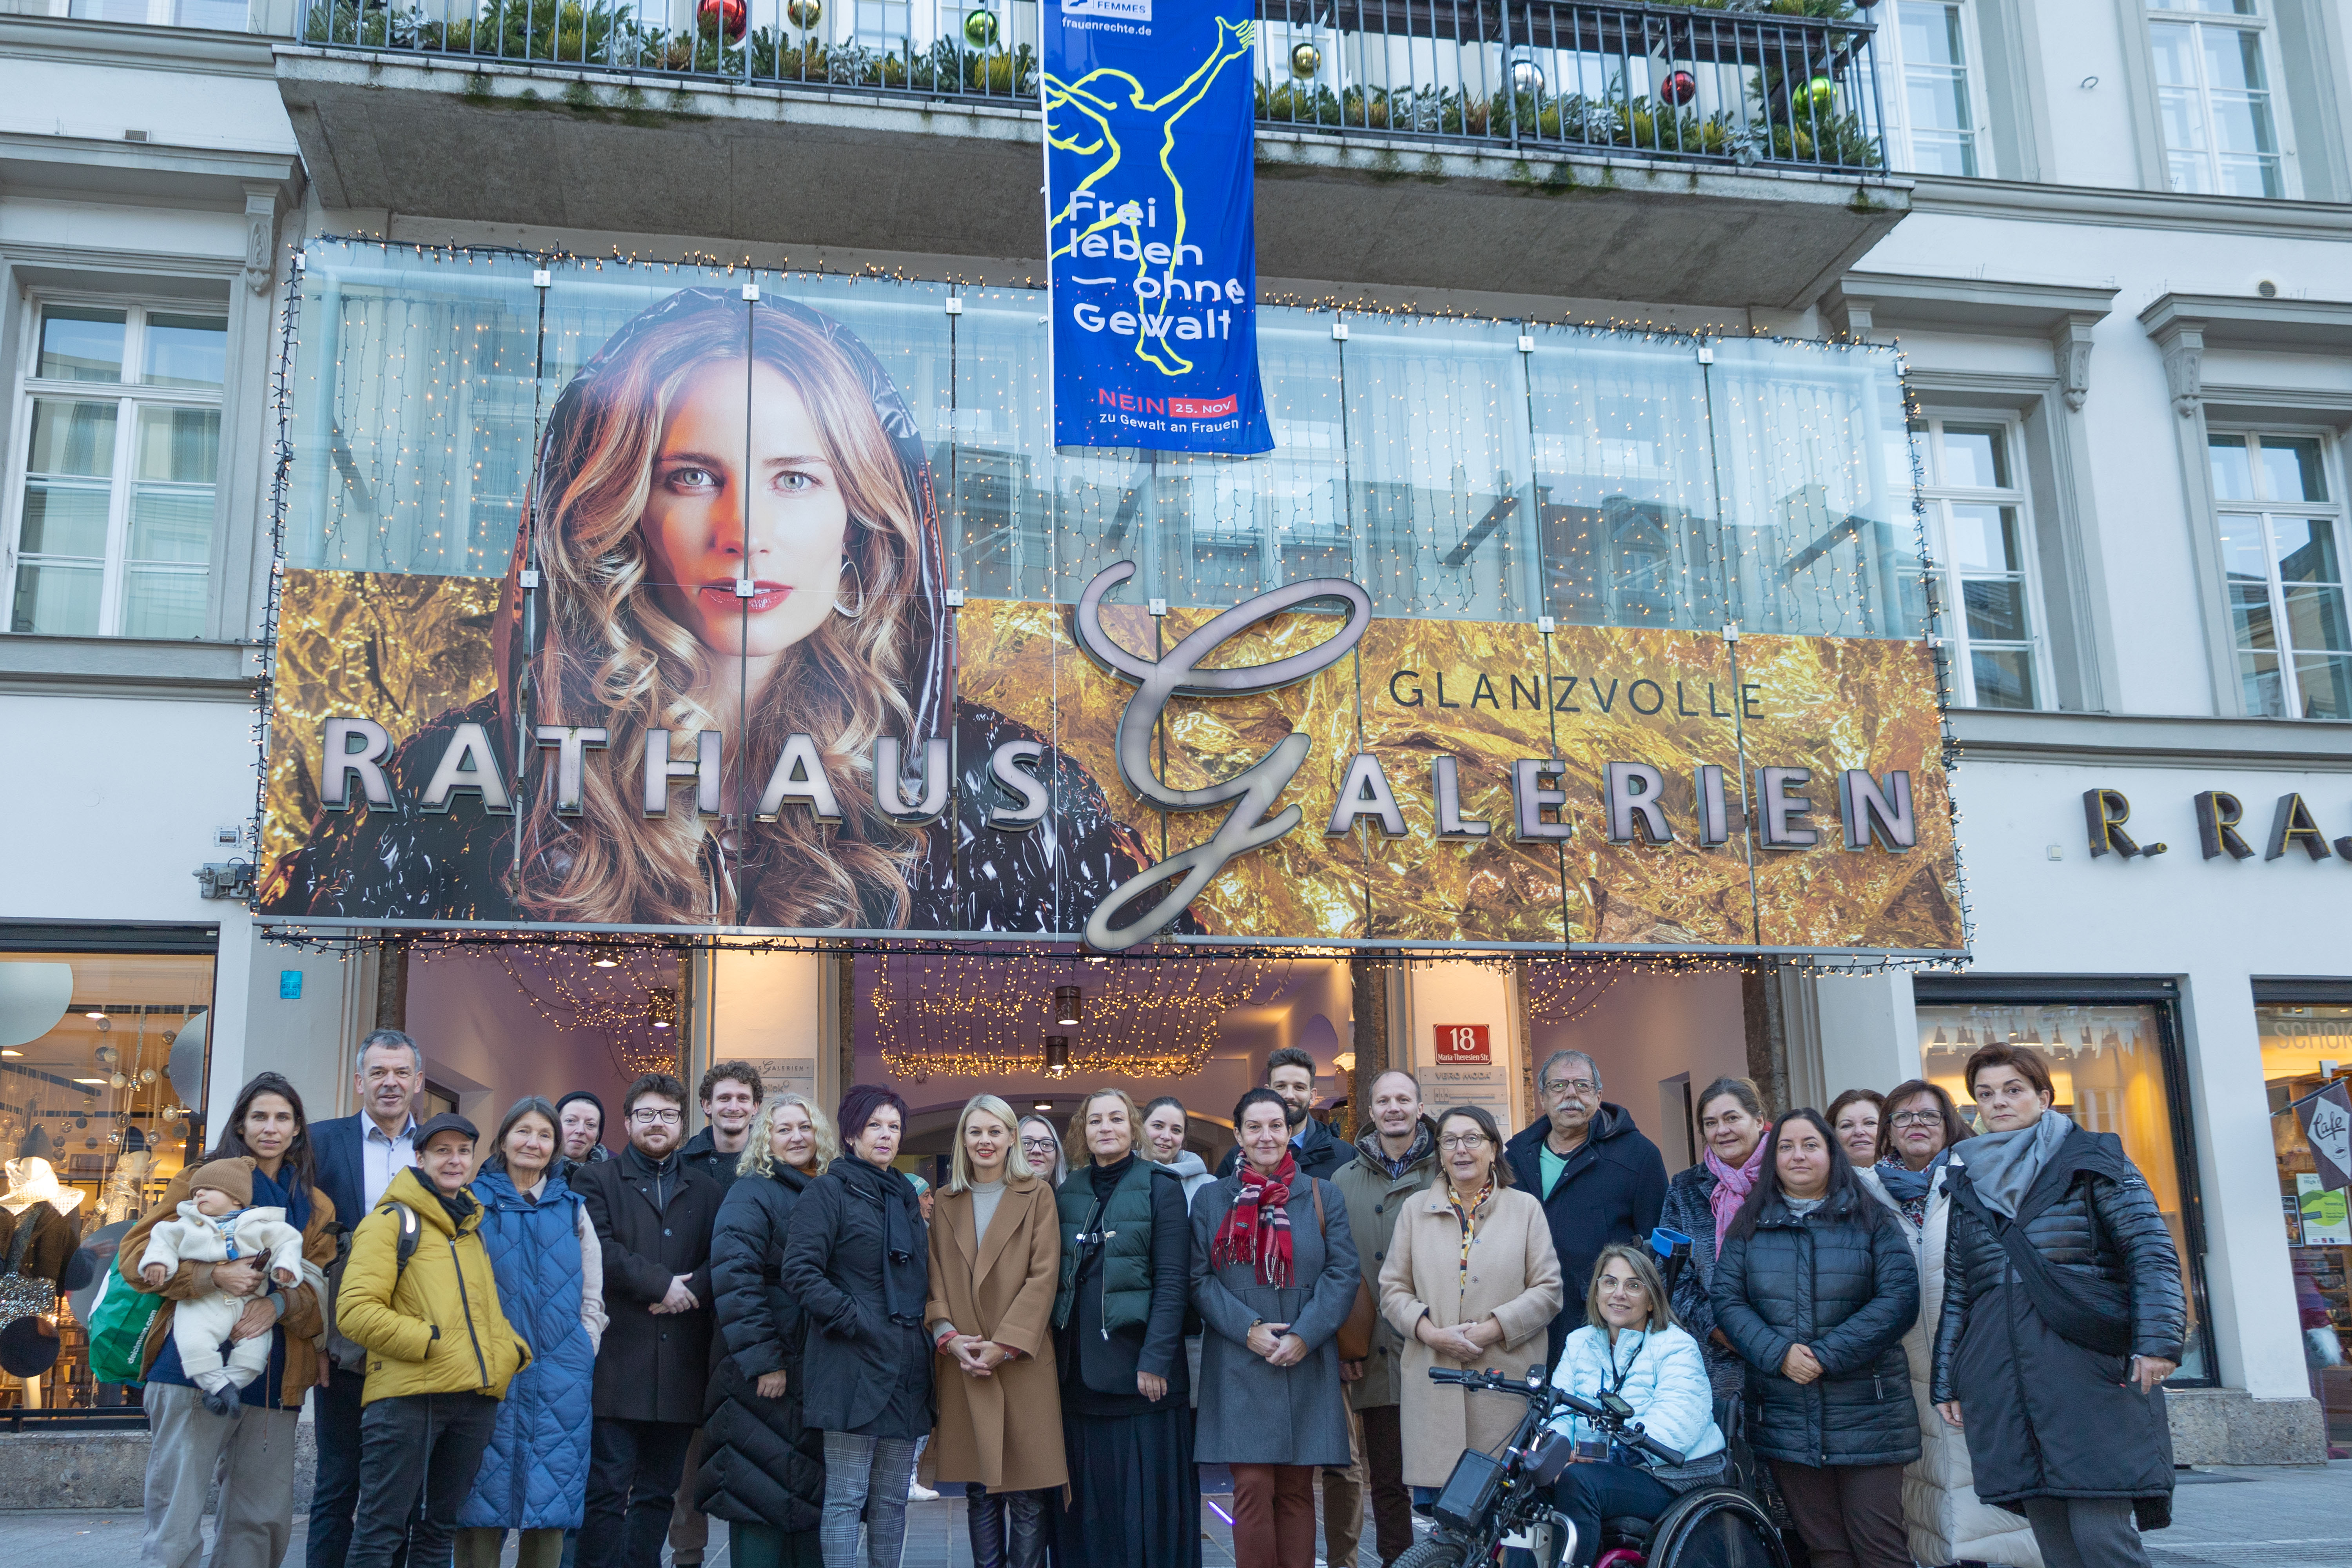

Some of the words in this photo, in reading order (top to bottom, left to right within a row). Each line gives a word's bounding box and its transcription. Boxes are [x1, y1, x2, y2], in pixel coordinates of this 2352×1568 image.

[1098, 2, 1145, 13] FEMMES
[1062, 16, 1152, 36] frauenrechte.de
[1070, 190, 1156, 227] Frei
[1070, 228, 1203, 266] leben
[1133, 270, 1245, 304] ohne
[1073, 303, 1231, 340] Gewalt
[1099, 388, 1165, 415] NEIN
[1175, 403, 1198, 414] 25.
[1203, 401, 1231, 413] NOV
[1100, 414, 1116, 423] zu
[1120, 414, 1166, 432] Gewalt
[1171, 422, 1187, 432] an
[1192, 419, 1239, 433] Frauen
[1388, 669, 1765, 720] GLANZVOLLE
[320, 716, 1051, 832] RATHAUS
[2082, 788, 2168, 858] R.
[2194, 790, 2352, 862] RA
[1450, 1027, 1475, 1051] 18
[1437, 1053, 1490, 1061] Maria-Theresien-Str.
[1435, 1072, 1461, 1080] VERO
[1463, 1072, 1491, 1080] MODA
